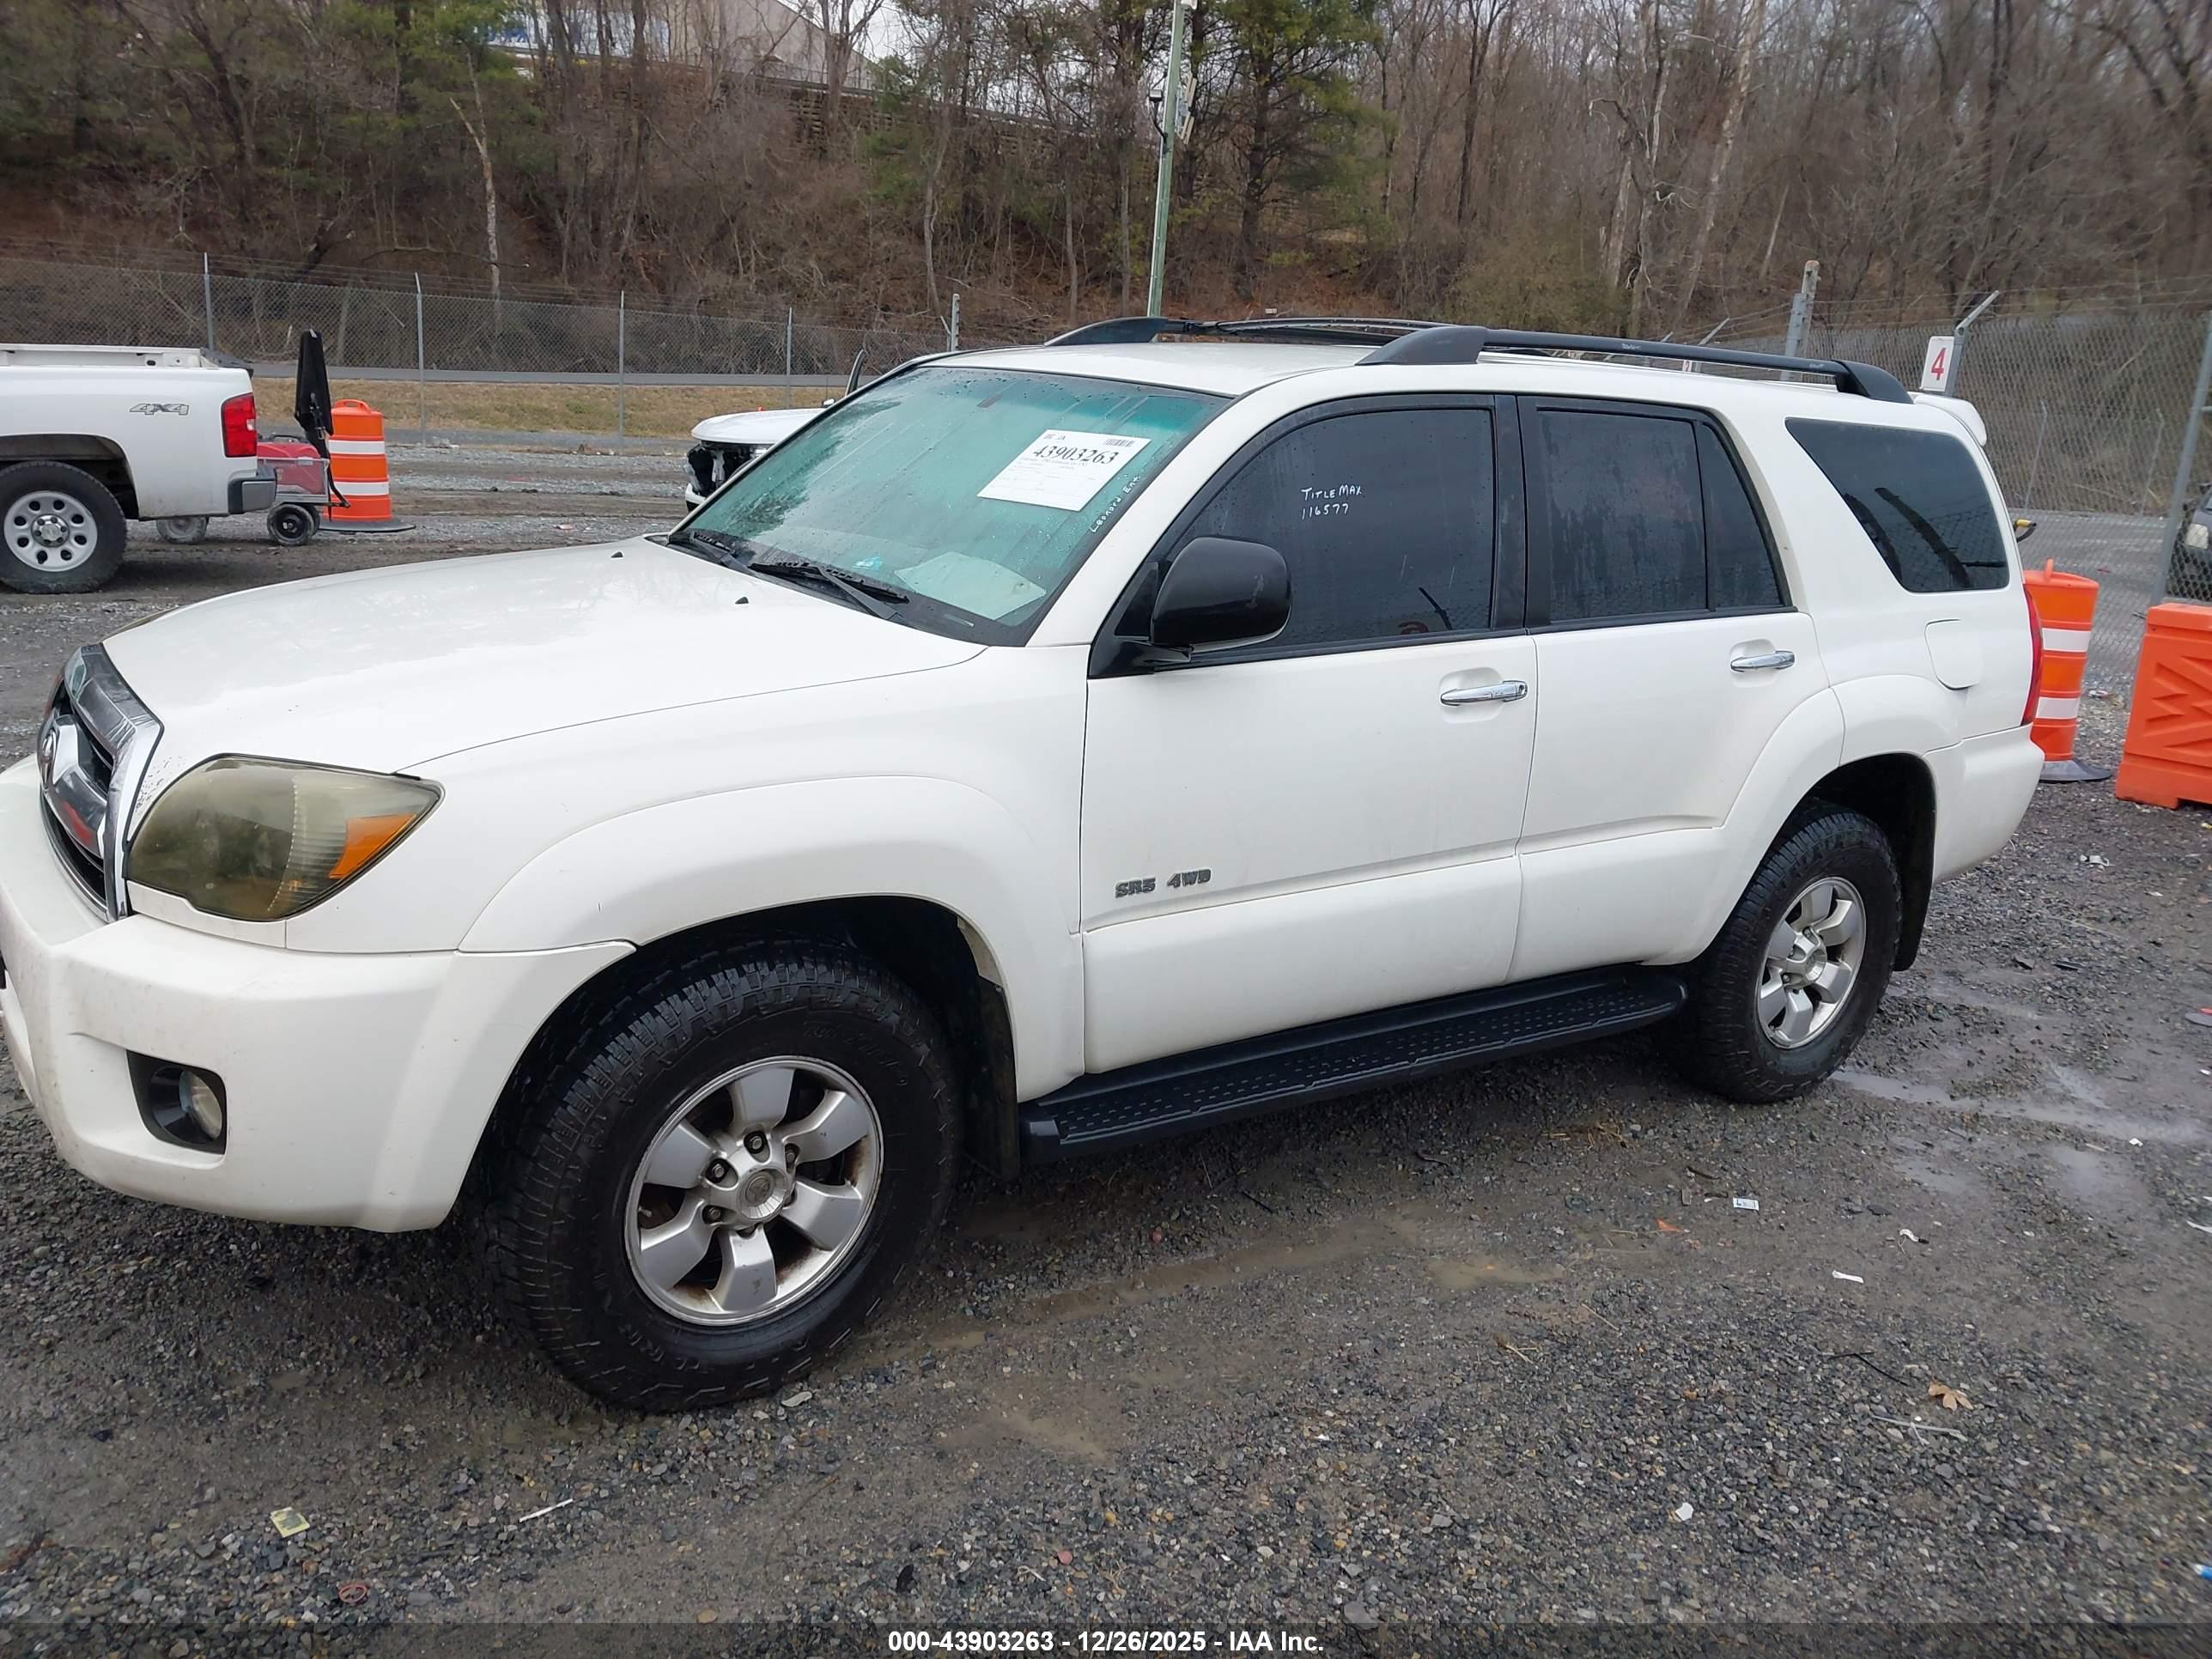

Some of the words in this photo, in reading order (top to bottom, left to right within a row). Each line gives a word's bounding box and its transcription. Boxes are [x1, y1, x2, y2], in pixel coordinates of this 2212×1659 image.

[1931, 348, 1946, 380] 4
[1033, 445, 1119, 464] 43903263
[1302, 502, 1349, 520] 116577
[1115, 877, 1156, 898] SR5
[1167, 869, 1211, 888] 4WD
